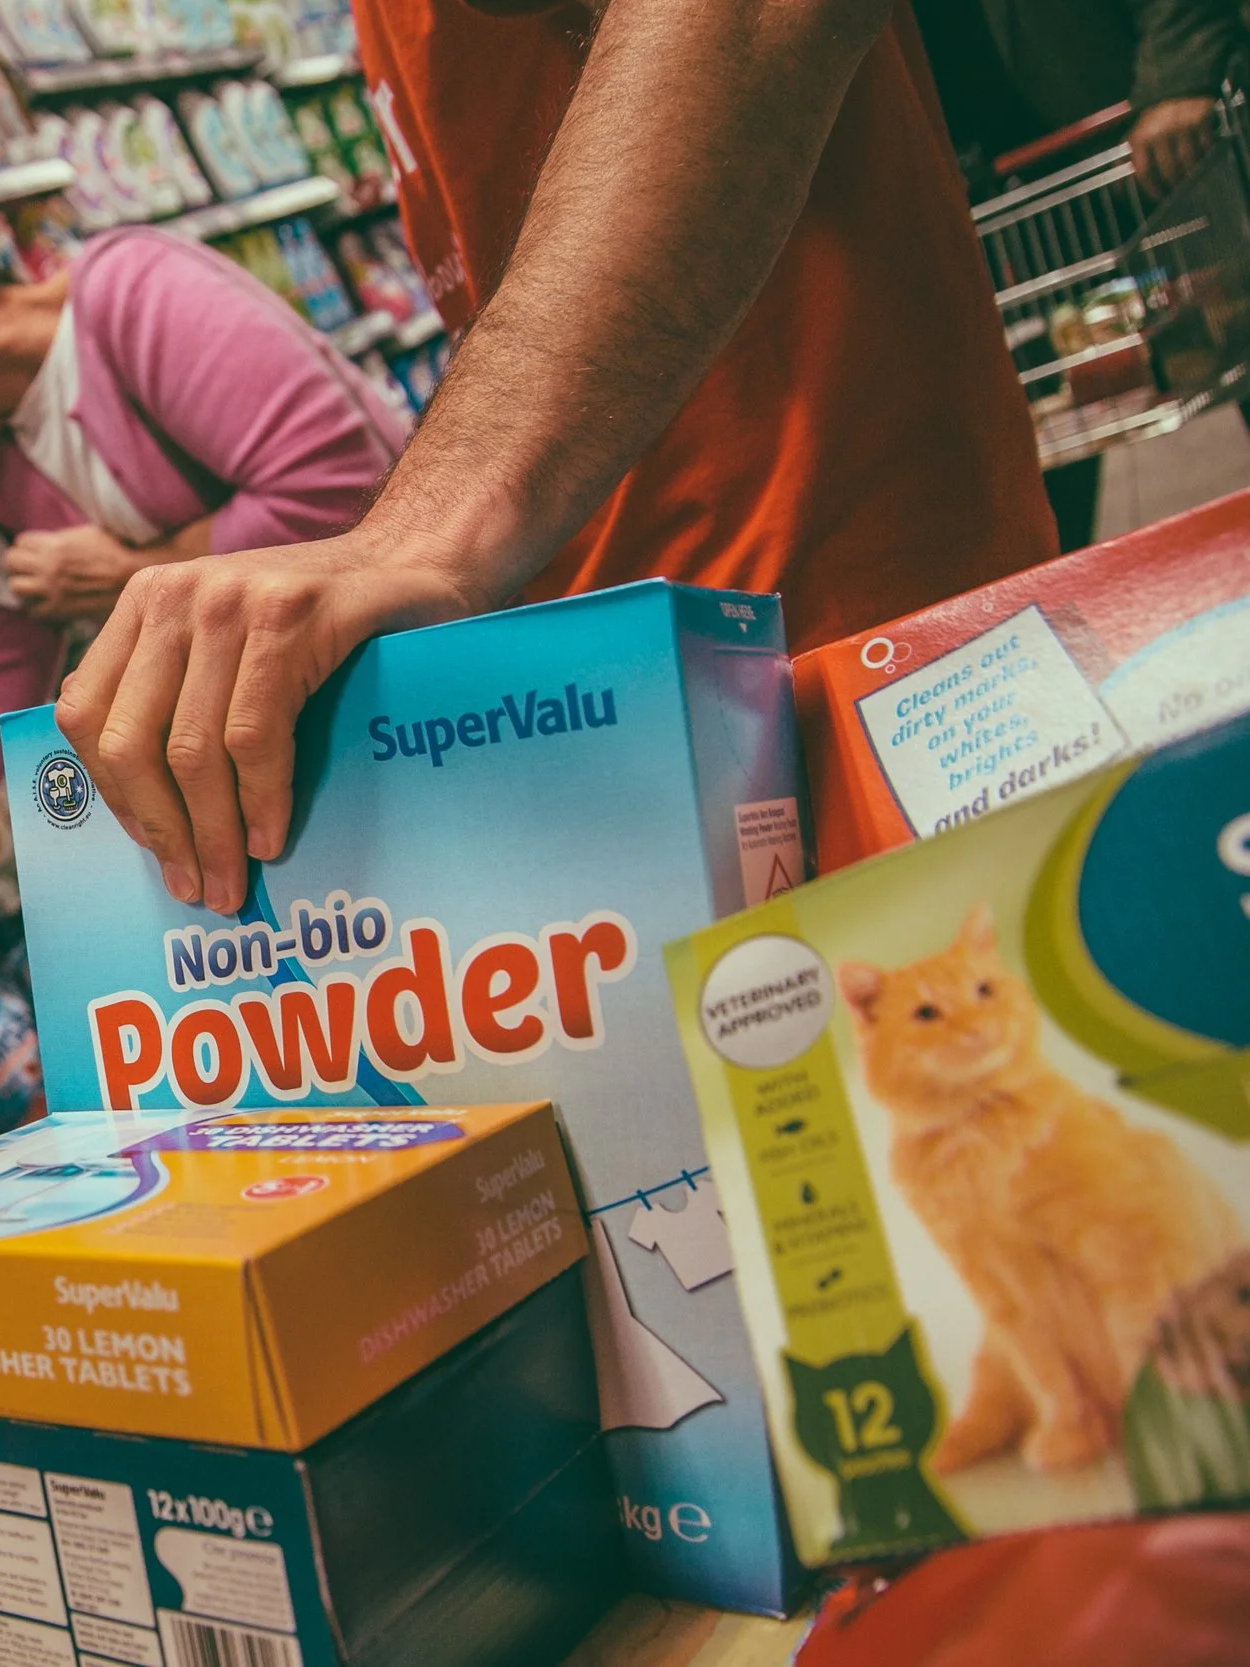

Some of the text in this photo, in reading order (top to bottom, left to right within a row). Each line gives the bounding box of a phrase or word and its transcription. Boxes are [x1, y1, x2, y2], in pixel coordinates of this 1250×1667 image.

[896, 634, 1021, 720] Cleans out
[368, 682, 618, 768] SuperValu
[890, 705, 947, 748] dirty
[927, 693, 1019, 751] on your
[934, 721, 1101, 836] and darks!
[948, 729, 1040, 792] brights
[170, 898, 387, 986] Non-bio
[94, 920, 628, 1112] Powder
[706, 966, 821, 1020] VETERINARY
[717, 988, 822, 1040] APPROVED
[206, 1133, 420, 1148] TABLETS
[227, 1123, 435, 1136] DISHWASHER
[475, 1149, 546, 1204] SuperValu
[499, 1190, 556, 1241] LEMON
[54, 1275, 179, 1314] SuperValu
[358, 1216, 564, 1368] DISHWASHER TABLETS
[42, 1325, 187, 1365] 30 LEMON
[61, 1357, 192, 1397] TABLETS
[822, 1379, 903, 1453] 12
[146, 1487, 246, 1538] 12x100g
[617, 1495, 663, 1540] kg
